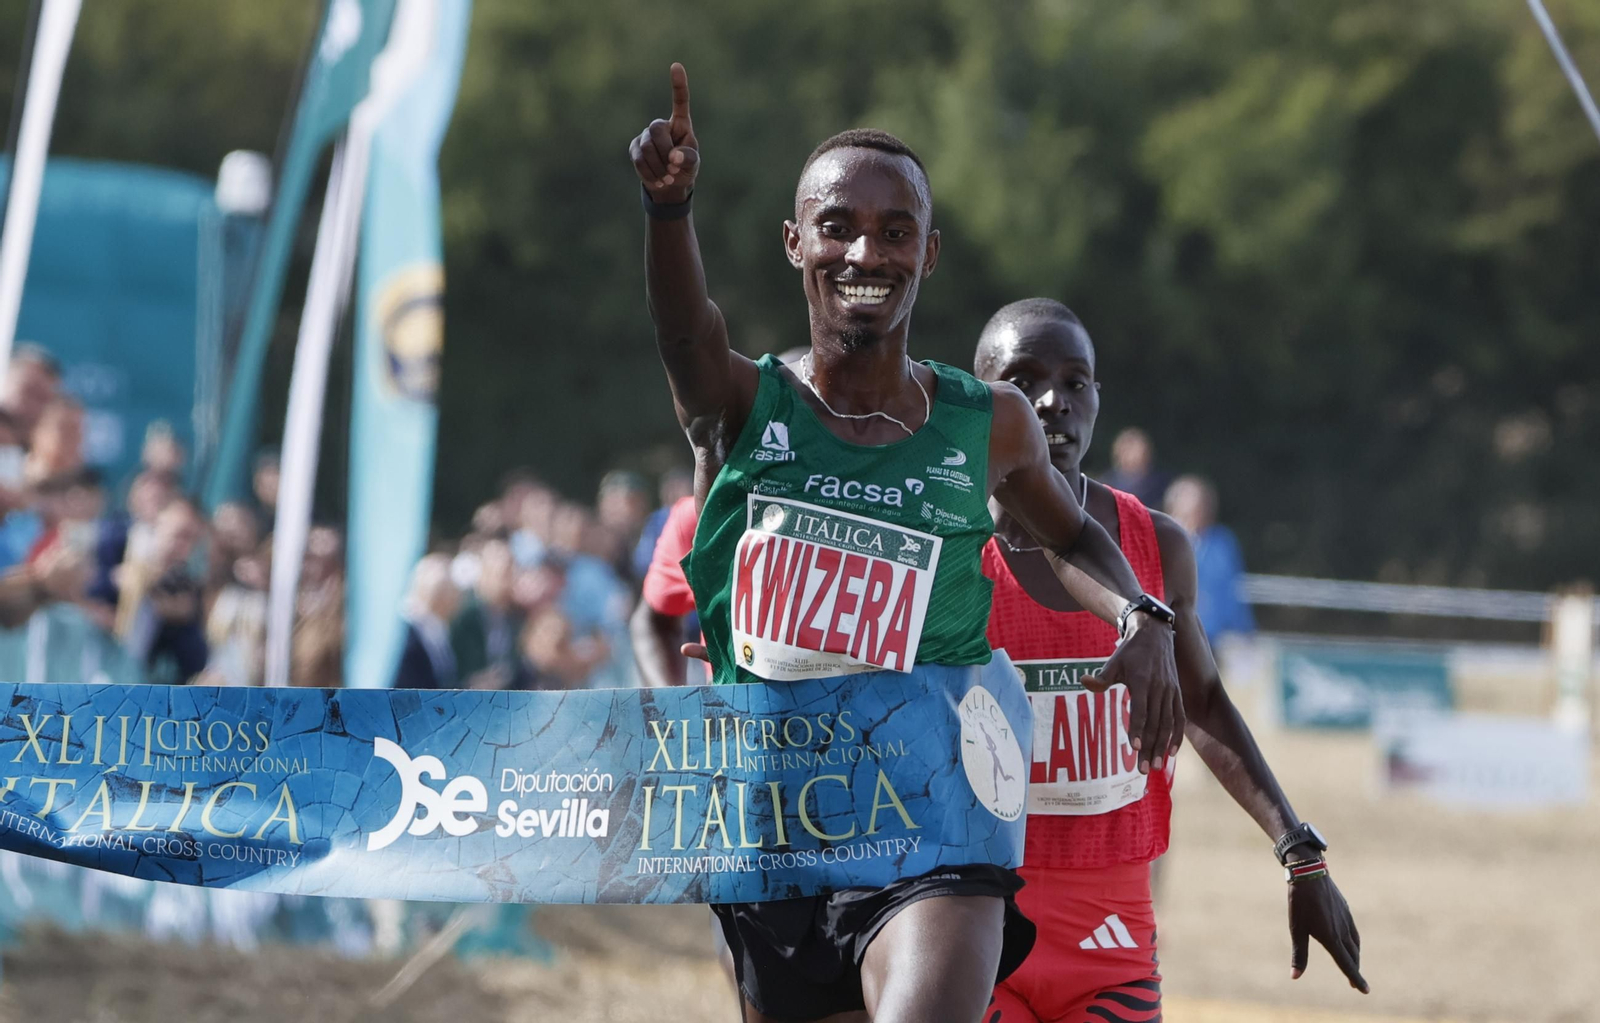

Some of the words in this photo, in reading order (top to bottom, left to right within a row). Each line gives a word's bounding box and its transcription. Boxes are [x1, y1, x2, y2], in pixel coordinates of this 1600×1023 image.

[750, 449, 796, 461] rasan
[804, 474, 903, 508] Facsa
[836, 500, 866, 511] integral
[794, 513, 884, 552] ITÁLICA
[935, 508, 968, 524] Diputació
[734, 534, 917, 671] KWIZERA
[10, 714, 154, 766] XLIII
[156, 719, 270, 752] CROSS
[646, 717, 744, 772] XLIII
[743, 711, 856, 751] CROSS
[743, 740, 911, 773] INTERNACIONAL
[155, 755, 312, 775] INTERNACIONAL
[500, 767, 613, 798] Diputación
[495, 798, 610, 838] Sevilla
[638, 768, 923, 851] ITÁLICA
[143, 837, 204, 859] CROSS
[208, 843, 302, 868] COUNTRY
[637, 855, 756, 875] INTERNATIONAL
[758, 849, 818, 871] CROSS
[821, 835, 923, 863] COUNTRY
